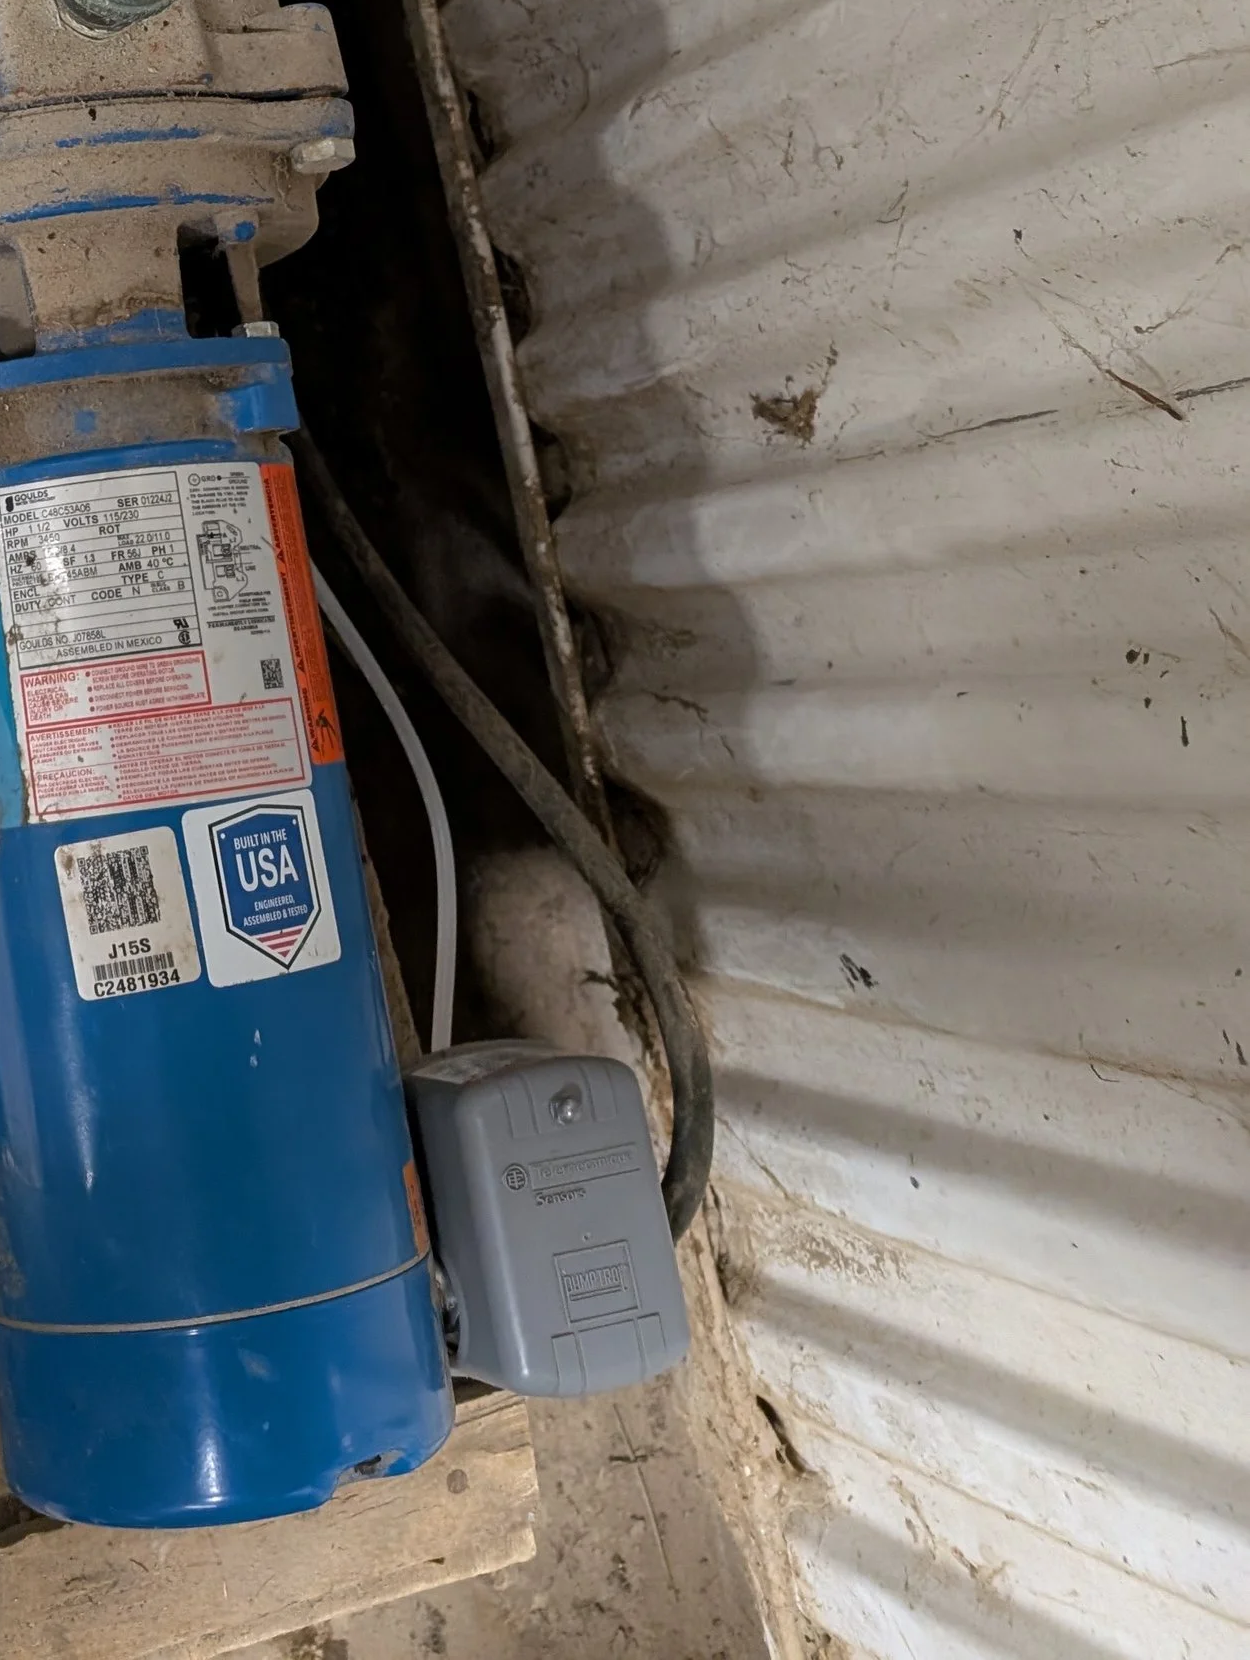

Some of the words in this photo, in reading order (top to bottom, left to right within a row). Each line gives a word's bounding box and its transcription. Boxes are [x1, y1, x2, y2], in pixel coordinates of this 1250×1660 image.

[14, 489, 48, 501] GOULDS
[3, 511, 39, 525] MODEL
[41, 502, 91, 518] C48C53A06
[116, 496, 139, 508] SER
[5, 527, 19, 537] HP
[28, 525, 32, 533] 1
[35, 522, 50, 532] 1/2
[63, 514, 99, 528] VOLTS
[103, 509, 139, 523] 115/230
[6, 538, 28, 549] RPM
[98, 523, 121, 535] ROT
[134, 530, 170, 544] 22.0/11.0
[9, 565, 22, 574] HZ
[30, 562, 42, 571] 60
[63, 557, 76, 566] SF
[84, 554, 95, 563] 1.3
[110, 551, 125, 560] FR
[151, 545, 166, 555] PH
[168, 544, 174, 553] 1
[117, 560, 142, 572] AMB
[146, 558, 159, 568] 40
[12, 588, 40, 599] ENCL
[121, 572, 149, 584] TYPE
[157, 570, 164, 579] C
[14, 600, 41, 612] DUTY
[48, 594, 77, 607] CONT
[91, 588, 122, 601] CODE
[131, 586, 140, 595] N
[177, 580, 185, 589] B
[18, 636, 53, 650] GOULDS
[54, 633, 71, 645] NO.
[71, 628, 106, 643] J07858L
[55, 641, 113, 658] ASSEMBLED
[113, 639, 124, 650] IN
[125, 634, 162, 649] MEXICO
[23, 671, 80, 688] WARNING:
[29, 712, 51, 721] DEATH
[29, 726, 102, 742] AVERTISSEMENT:
[233, 834, 259, 850] BUILT
[260, 832, 271, 846] IN
[272, 828, 288, 844] THE
[234, 844, 299, 892] USA
[254, 894, 296, 912] ENGINEERED,
[243, 910, 282, 927] ASSEMBLED
[288, 904, 308, 918] TESTED
[108, 938, 151, 960] J15S
[93, 968, 181, 998] C2481934
[535, 1186, 587, 1206] Sensors
